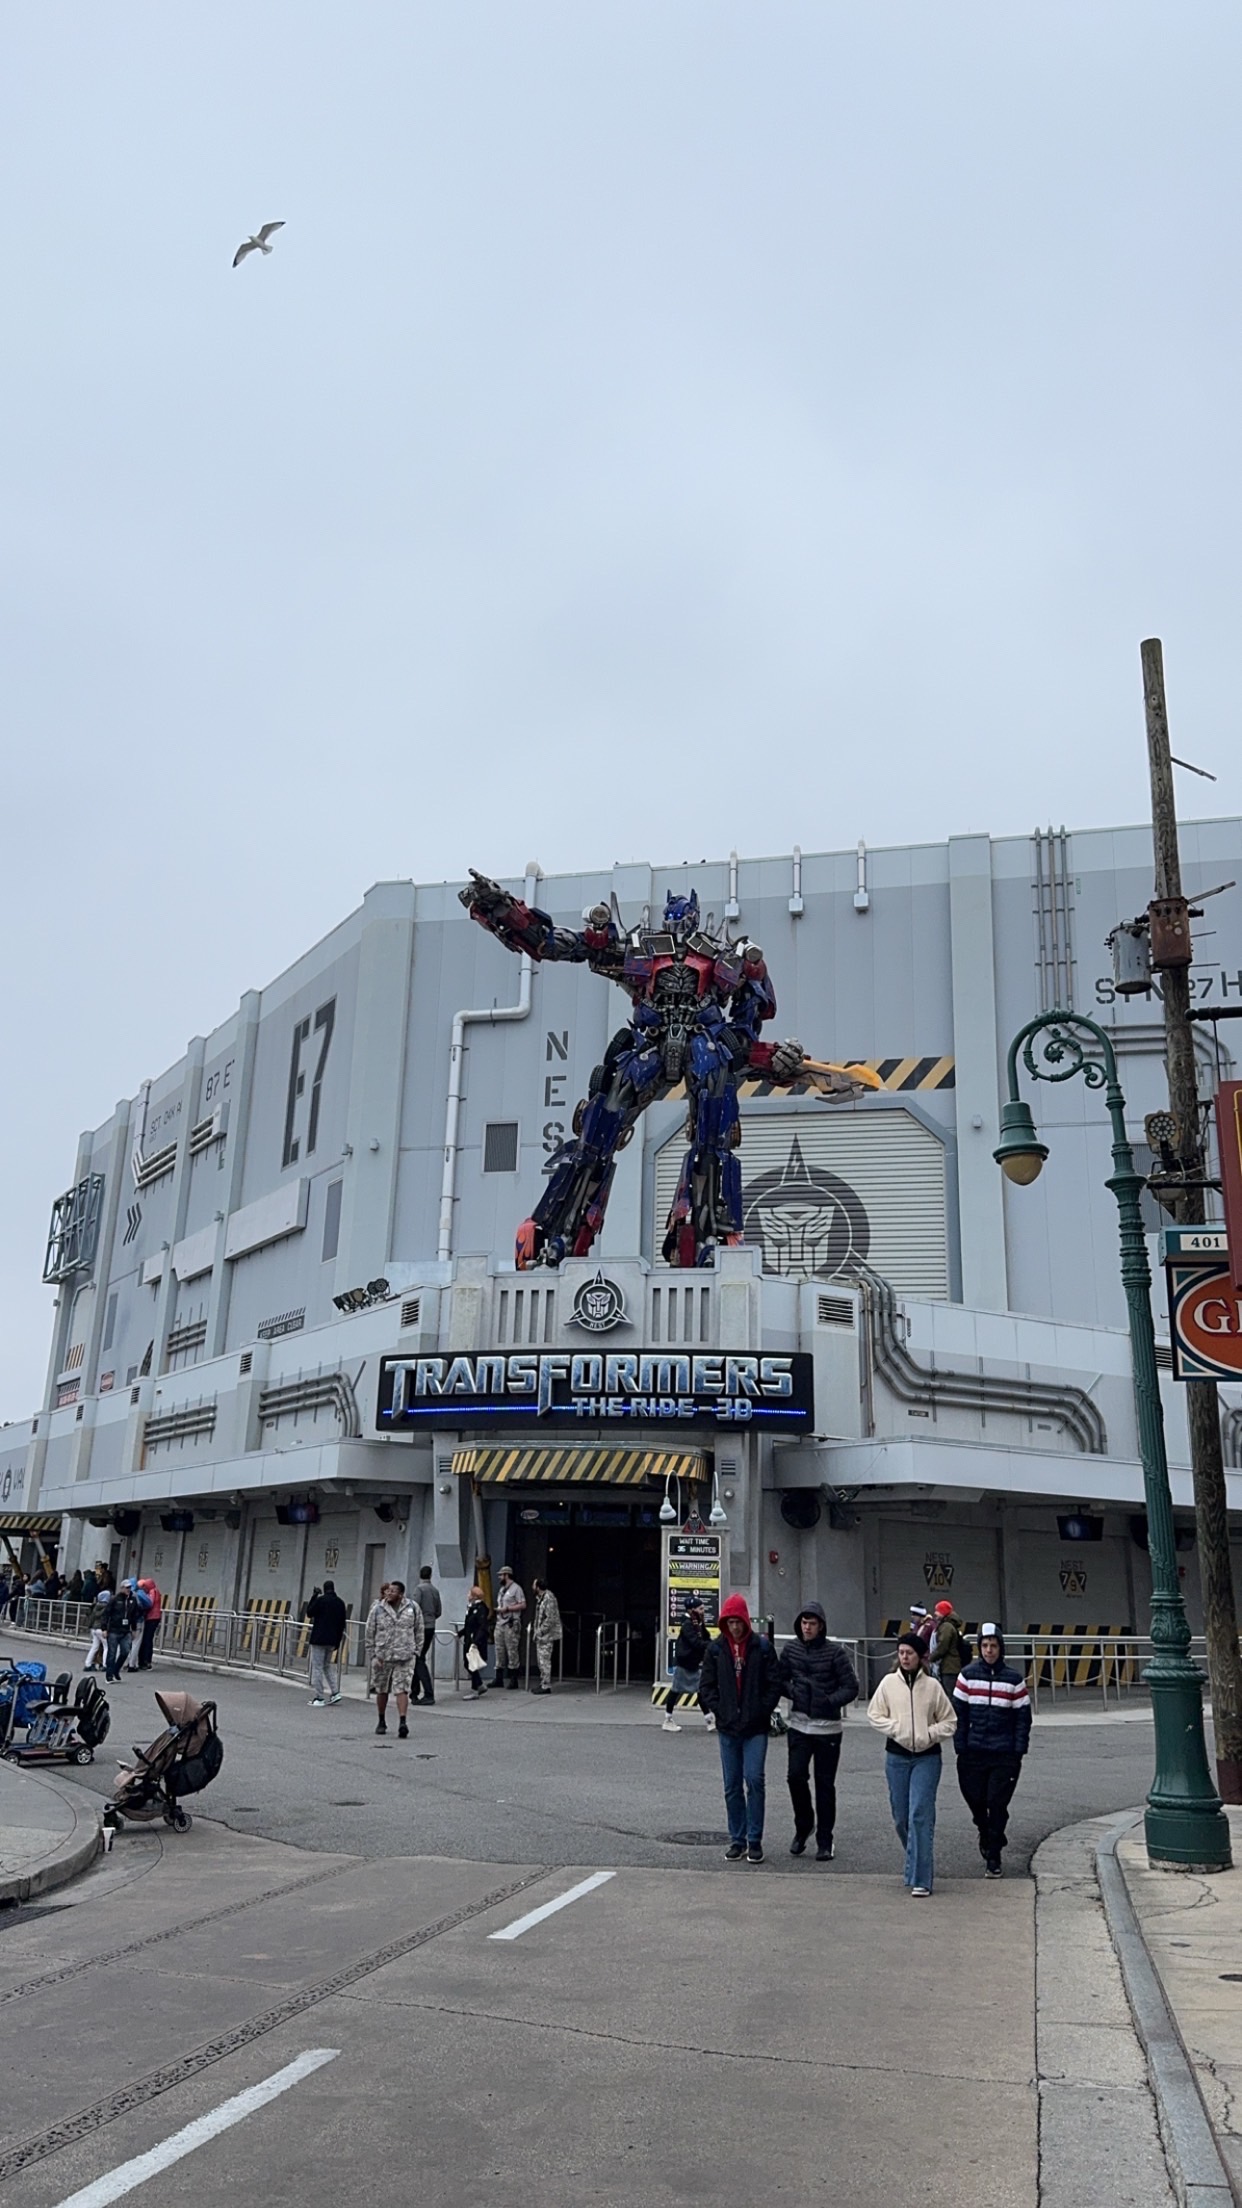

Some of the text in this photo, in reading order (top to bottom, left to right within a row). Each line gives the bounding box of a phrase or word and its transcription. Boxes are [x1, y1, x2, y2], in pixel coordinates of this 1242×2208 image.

[1095, 975, 1165, 1004] SN
[280, 992, 338, 1174] E7
[541, 1031, 568, 1182] NES
[1191, 1236, 1220, 1248] 401
[384, 1354, 794, 1420] TRANSFORMERS
[571, 1397, 625, 1418] THE
[690, 1546, 717, 1554] MINUTES
[925, 1551, 951, 1564] NEST
[679, 1562, 711, 1570] WARNING
[925, 1566, 953, 1580] 7 7
[934, 1573, 945, 1586] 10
[1061, 1572, 1086, 1586] 7 7
